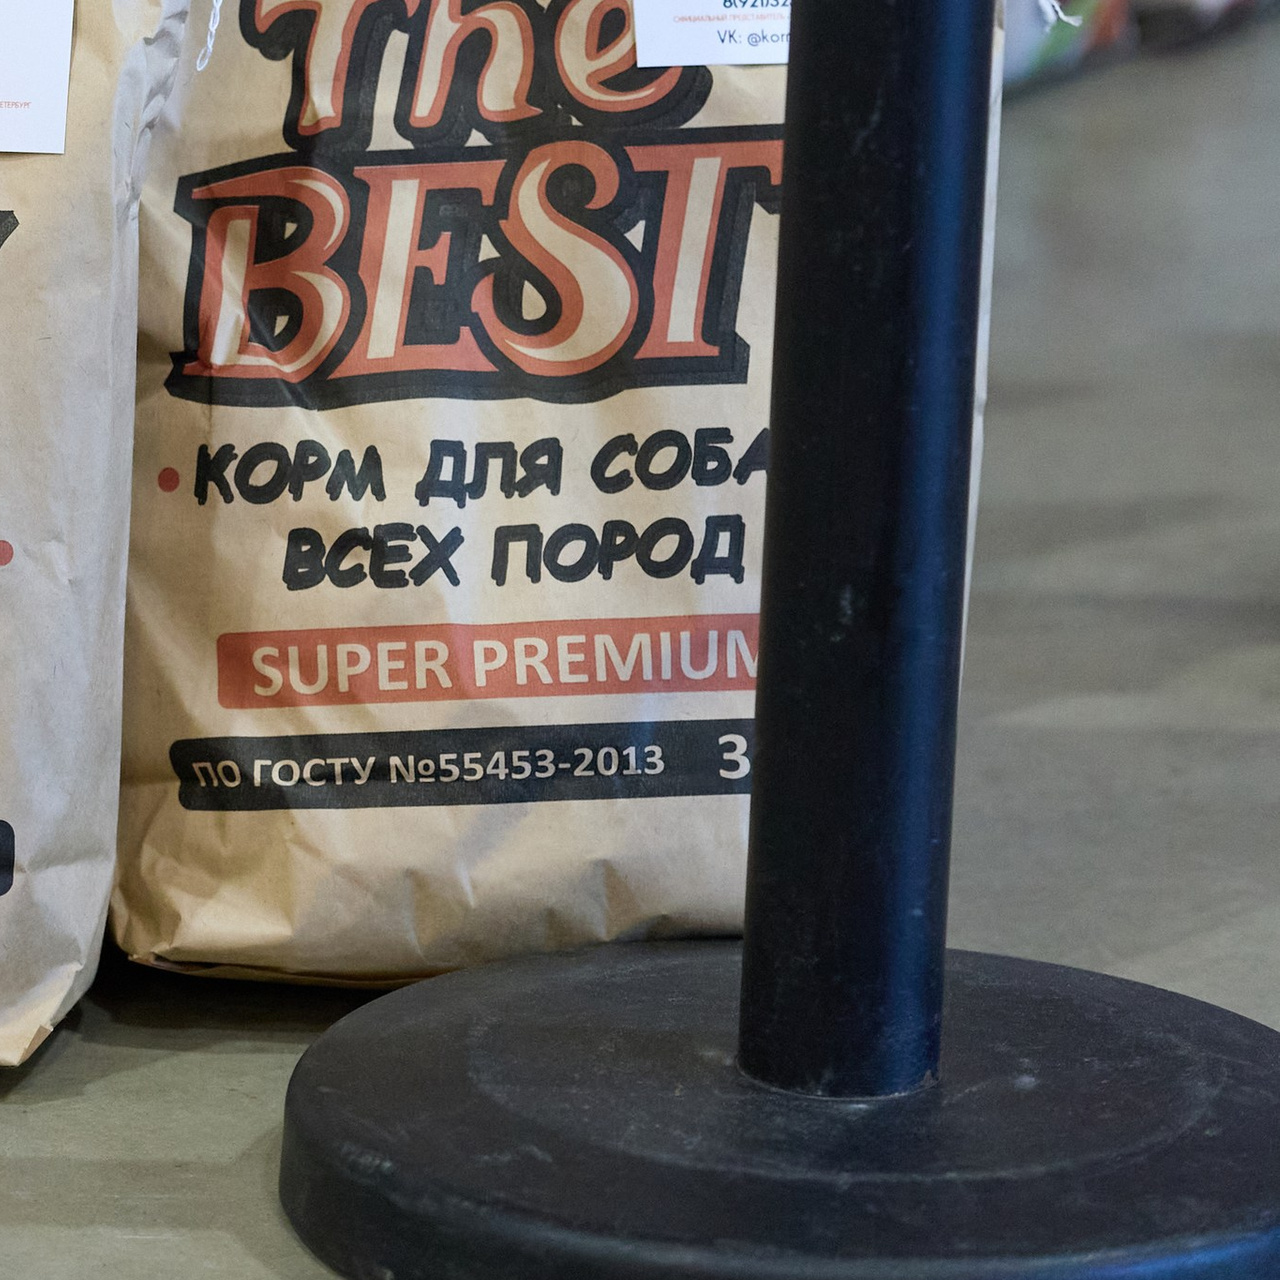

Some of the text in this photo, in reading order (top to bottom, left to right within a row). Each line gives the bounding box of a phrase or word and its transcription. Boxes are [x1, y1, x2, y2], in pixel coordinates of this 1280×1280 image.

[163, 124, 785, 412] BEST
[194, 427, 771, 509] КОРМ ДЛЯ СОБА
[282, 514, 746, 591] ВСЕХ ПОРОД
[251, 636, 454, 697] SUPER
[191, 733, 752, 790] ПО ГОСТУ №55453-2013 3
